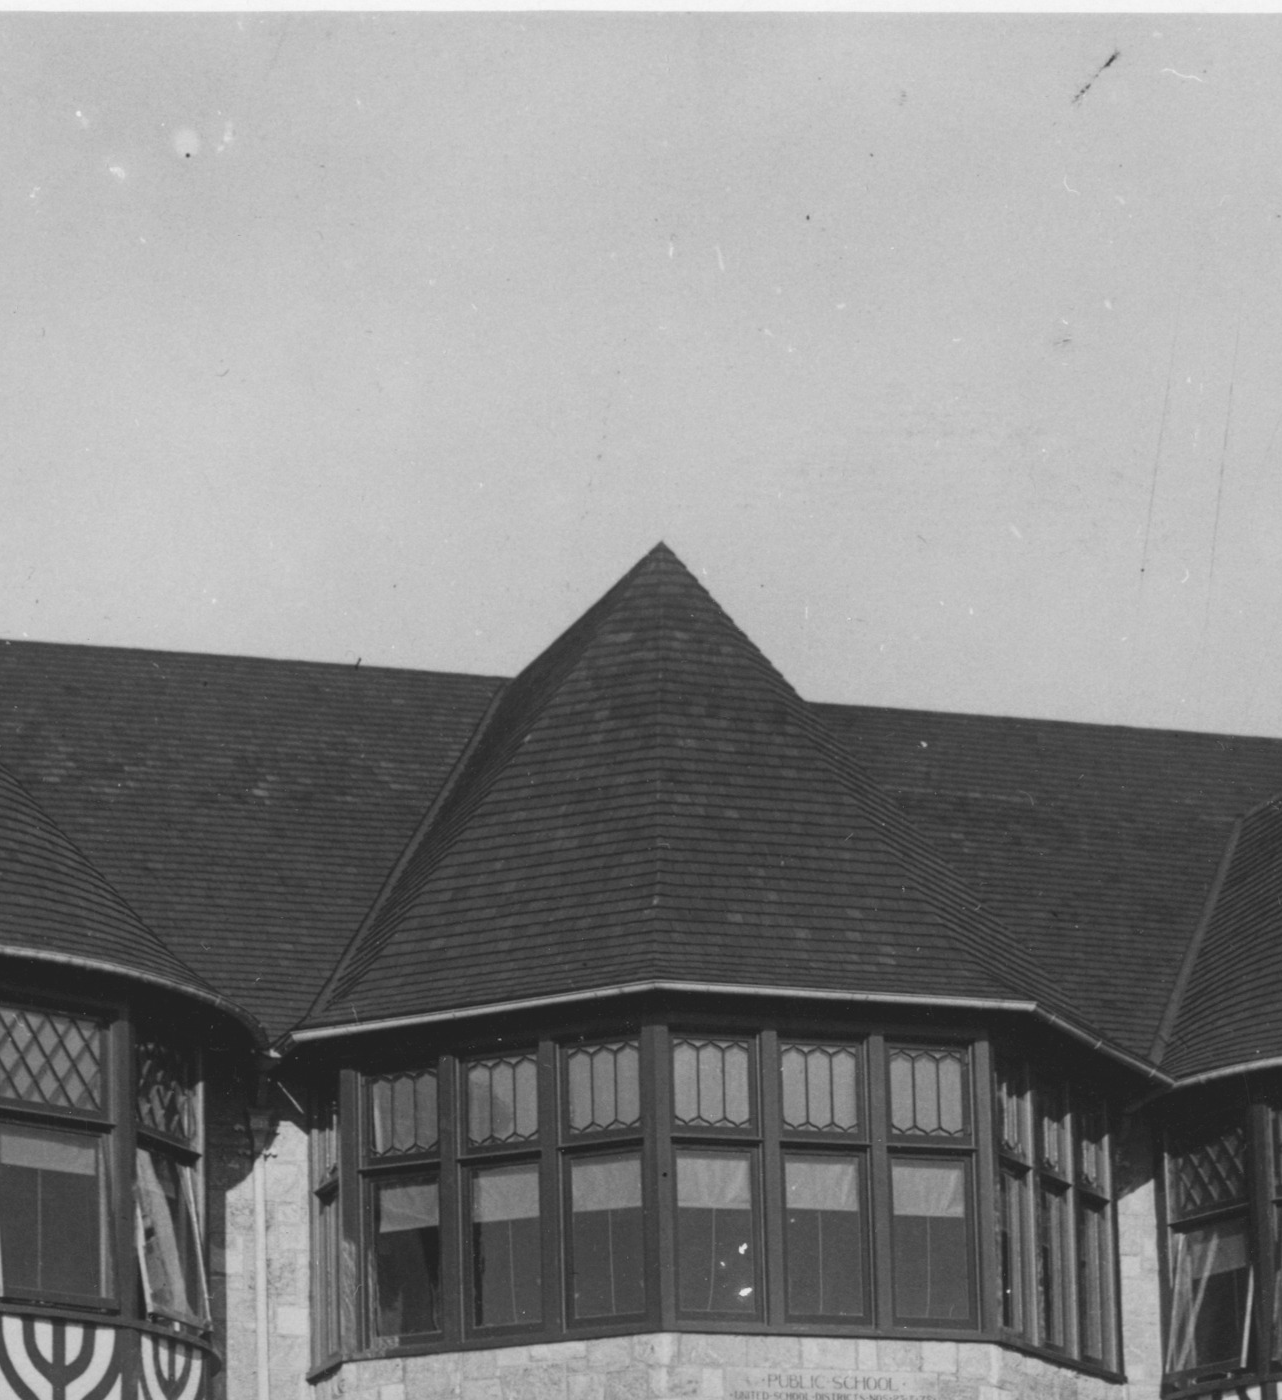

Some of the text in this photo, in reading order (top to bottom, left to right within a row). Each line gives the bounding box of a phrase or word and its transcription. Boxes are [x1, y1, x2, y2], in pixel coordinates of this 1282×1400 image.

[768, 1374, 899, 1391] PUBLIC SCHOOL
[734, 1390, 769, 1400] UNITED
